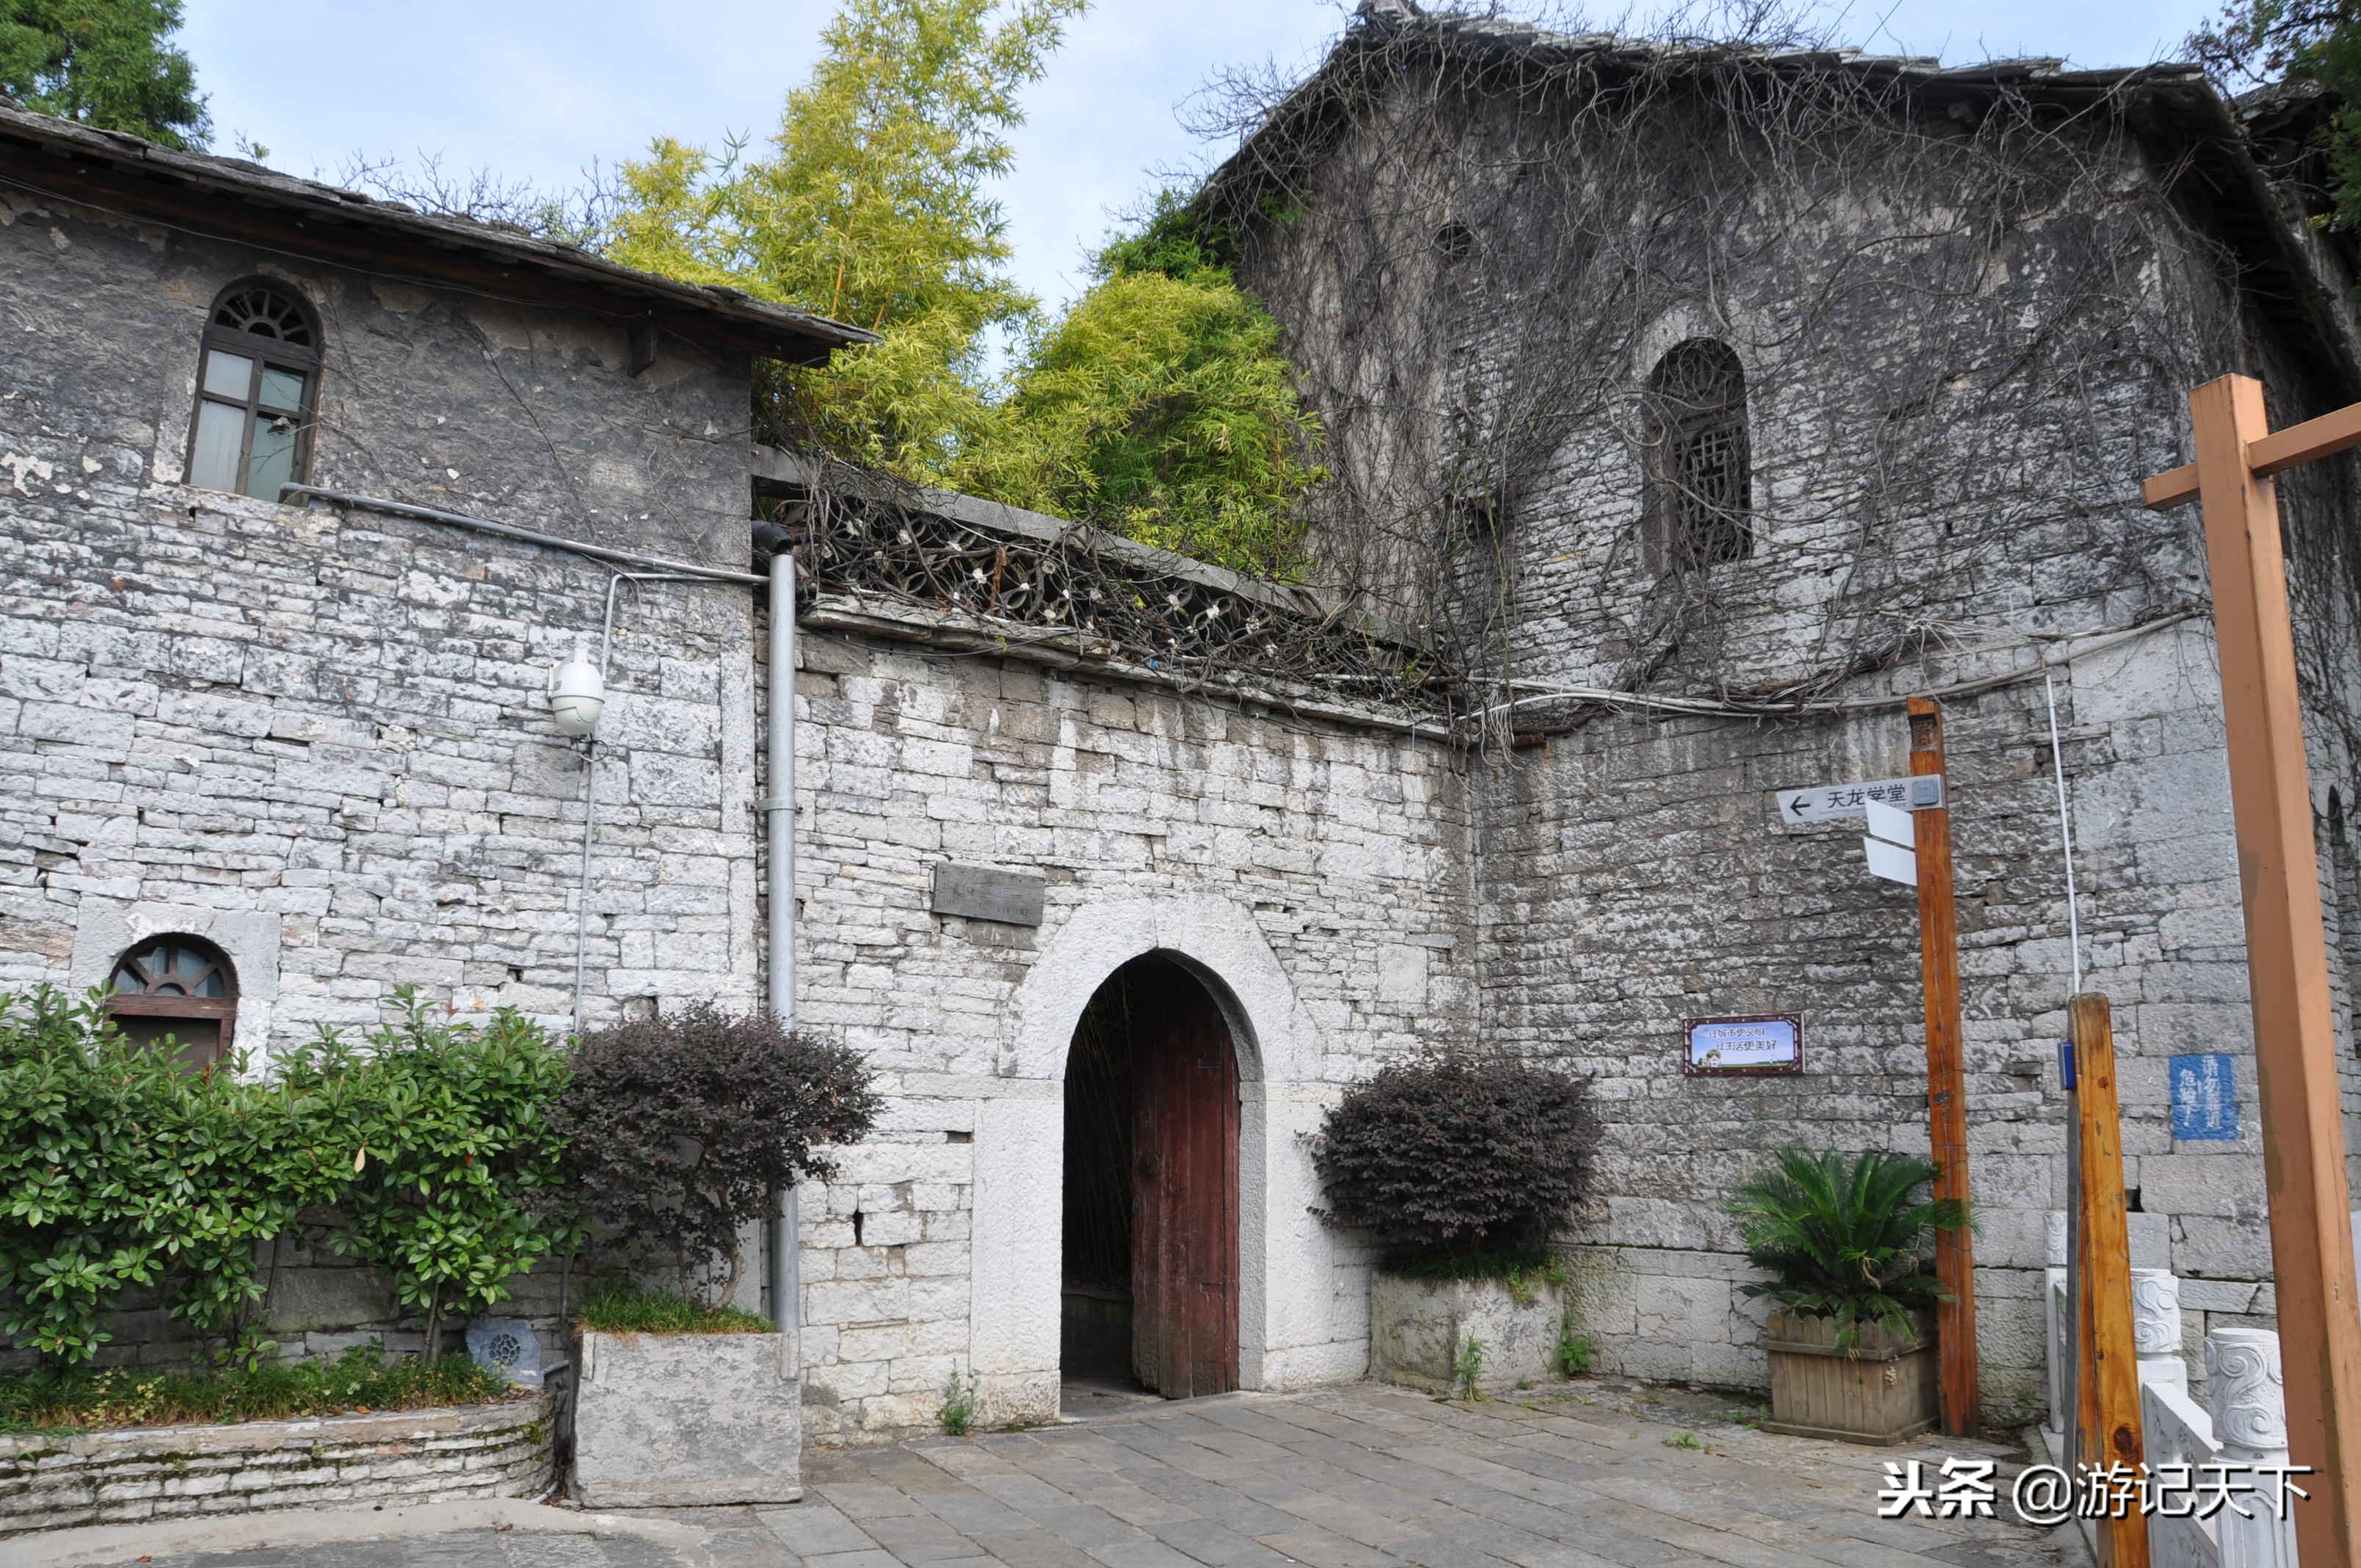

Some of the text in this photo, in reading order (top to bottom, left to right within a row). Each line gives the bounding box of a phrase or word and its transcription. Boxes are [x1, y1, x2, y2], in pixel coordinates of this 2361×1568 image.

[1827, 784, 1906, 807] 天龙学堂
[1709, 1027, 1765, 1039] 让城市更文明
[1716, 1040, 1777, 1051] 让生活更美好
